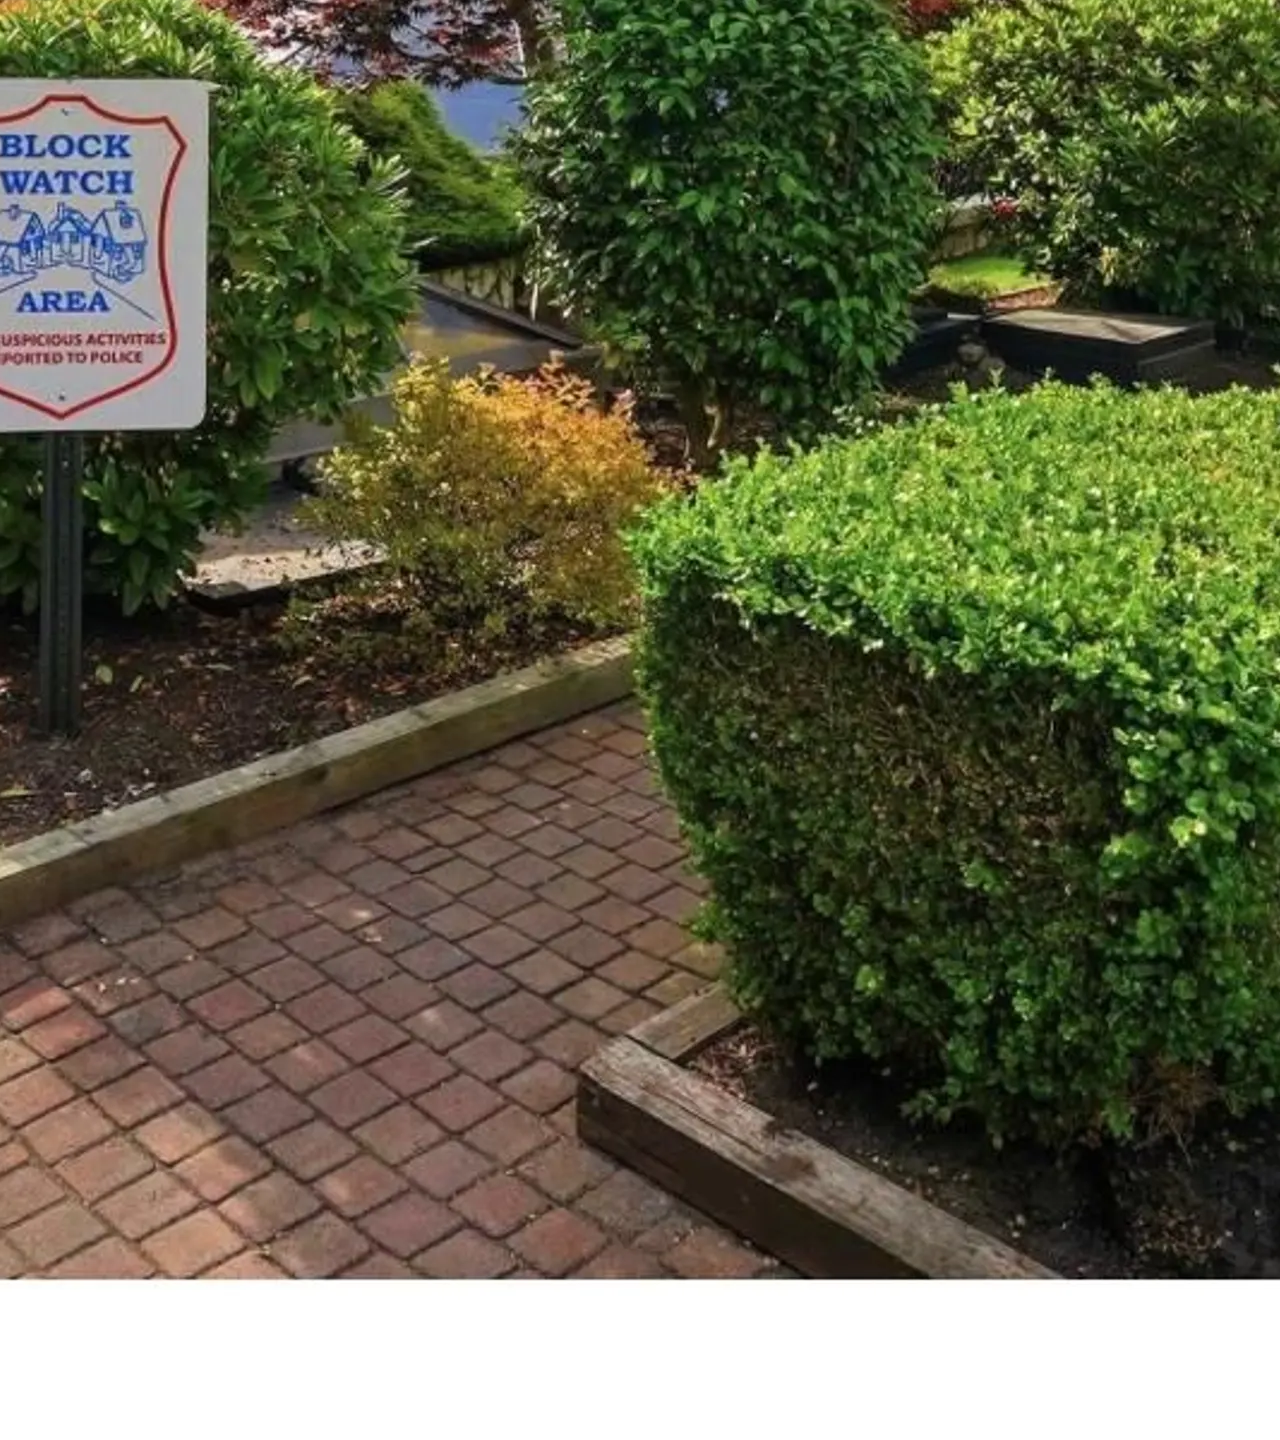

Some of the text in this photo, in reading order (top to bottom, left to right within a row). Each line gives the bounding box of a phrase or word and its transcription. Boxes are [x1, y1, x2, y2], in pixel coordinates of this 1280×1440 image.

[16, 290, 110, 313] AREA
[86, 333, 166, 345] ACTIVITIES
[67, 352, 87, 364] TO
[90, 351, 143, 364] POLICE
